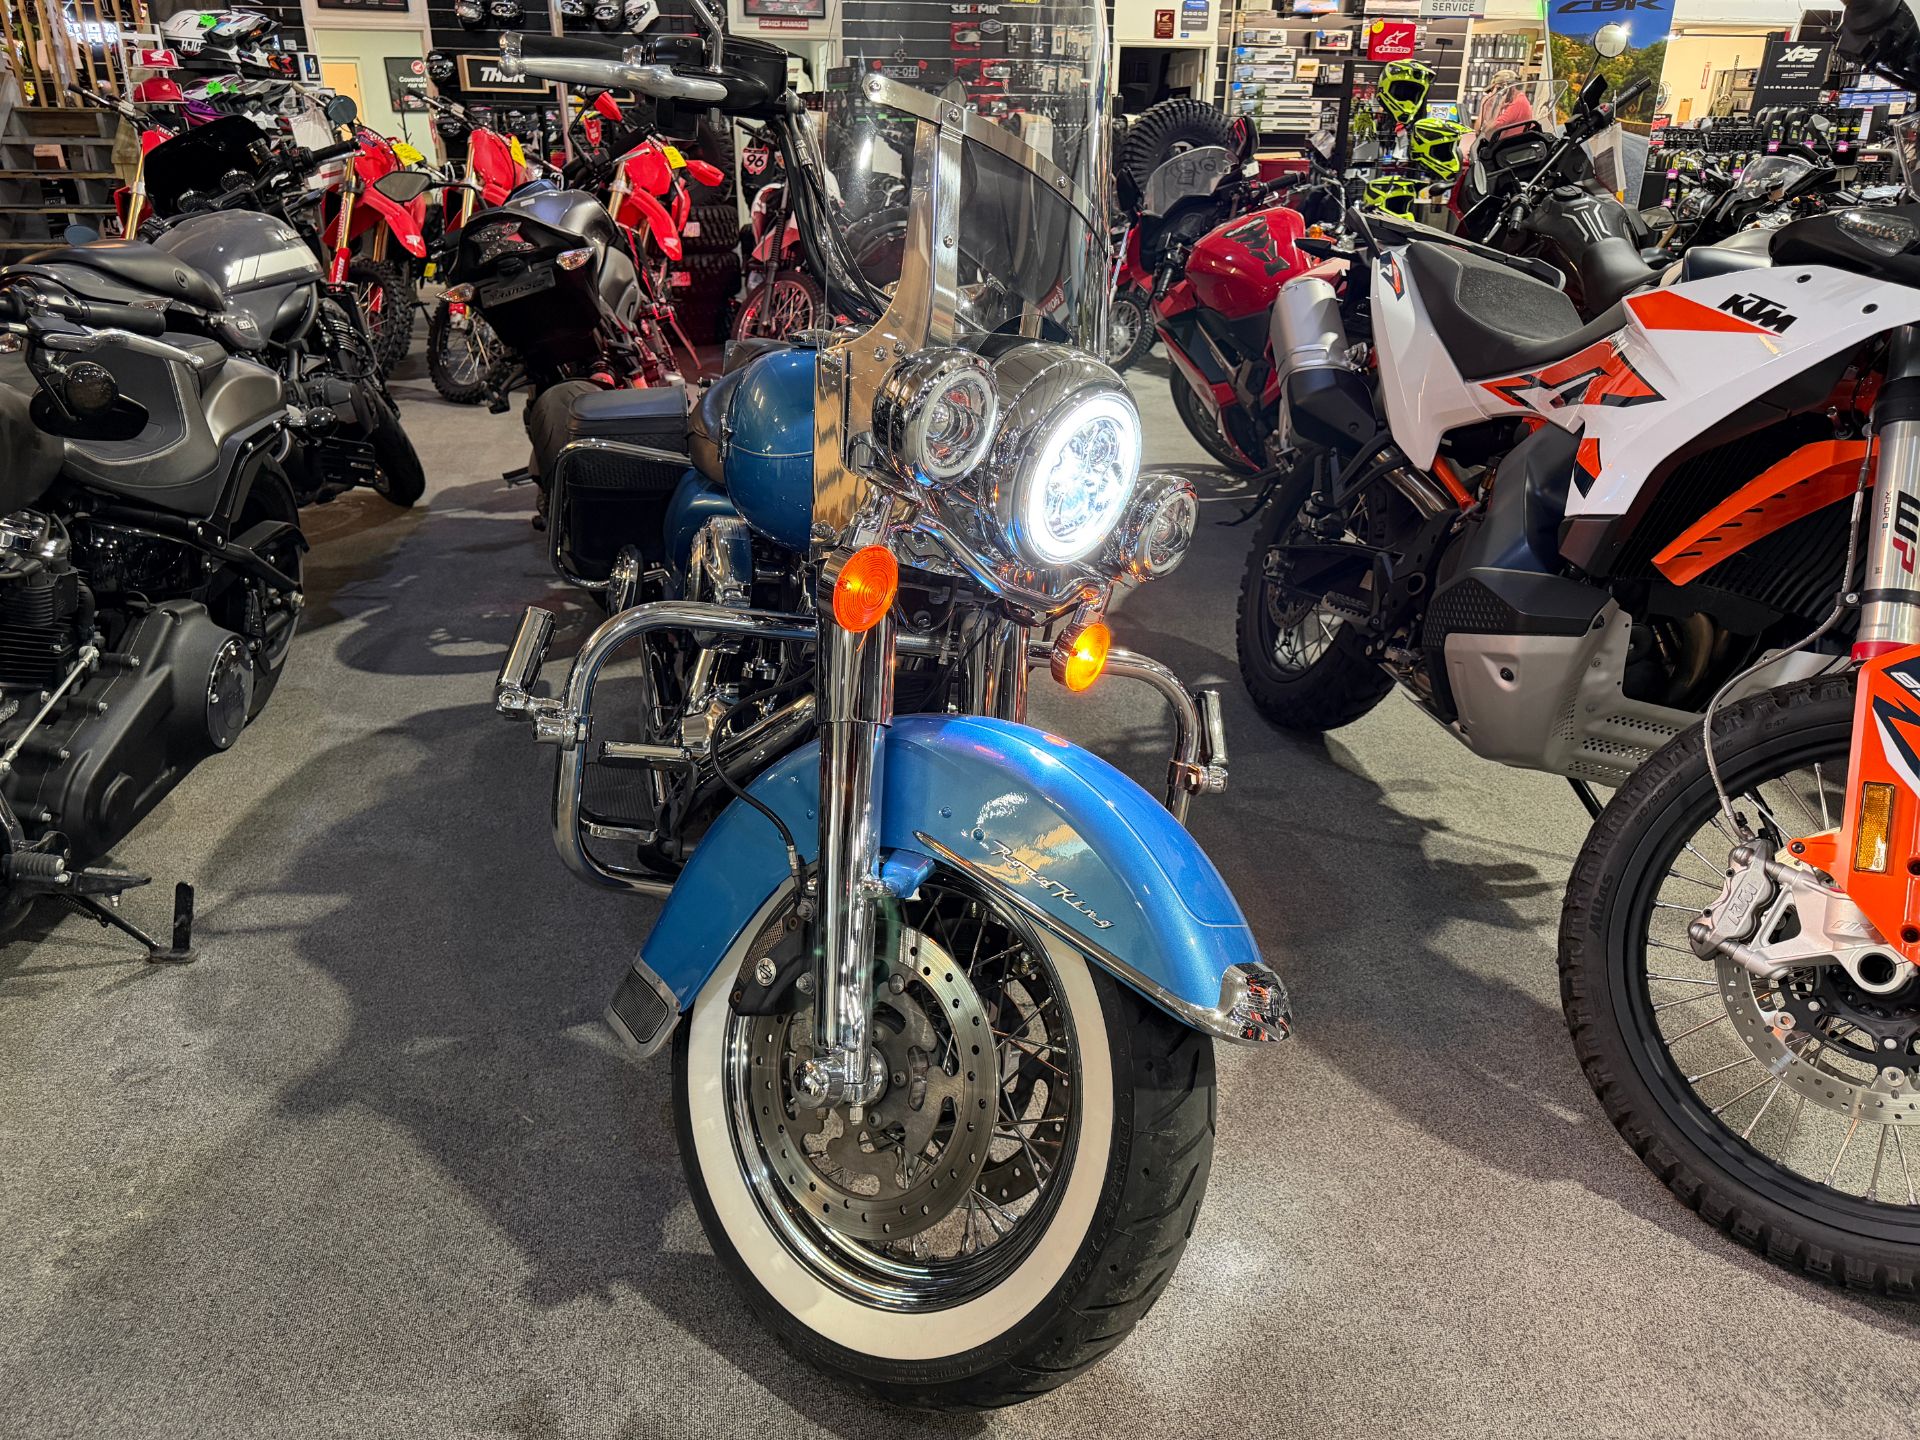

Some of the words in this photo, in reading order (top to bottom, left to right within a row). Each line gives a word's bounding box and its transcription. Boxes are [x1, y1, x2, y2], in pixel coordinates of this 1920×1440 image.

[951, 4, 1000, 14] SEIZMIK
[1432, 3, 1475, 12] SERVICE
[181, 40, 202, 51] HJC
[1777, 45, 1822, 62] XPS
[883, 67, 918, 78] Muc-Off
[747, 154, 764, 167] 96
[1717, 293, 1798, 334] KTM
[990, 840, 1052, 889] Road
[1051, 880, 1116, 930] King
[1727, 883, 1759, 926] KTM
